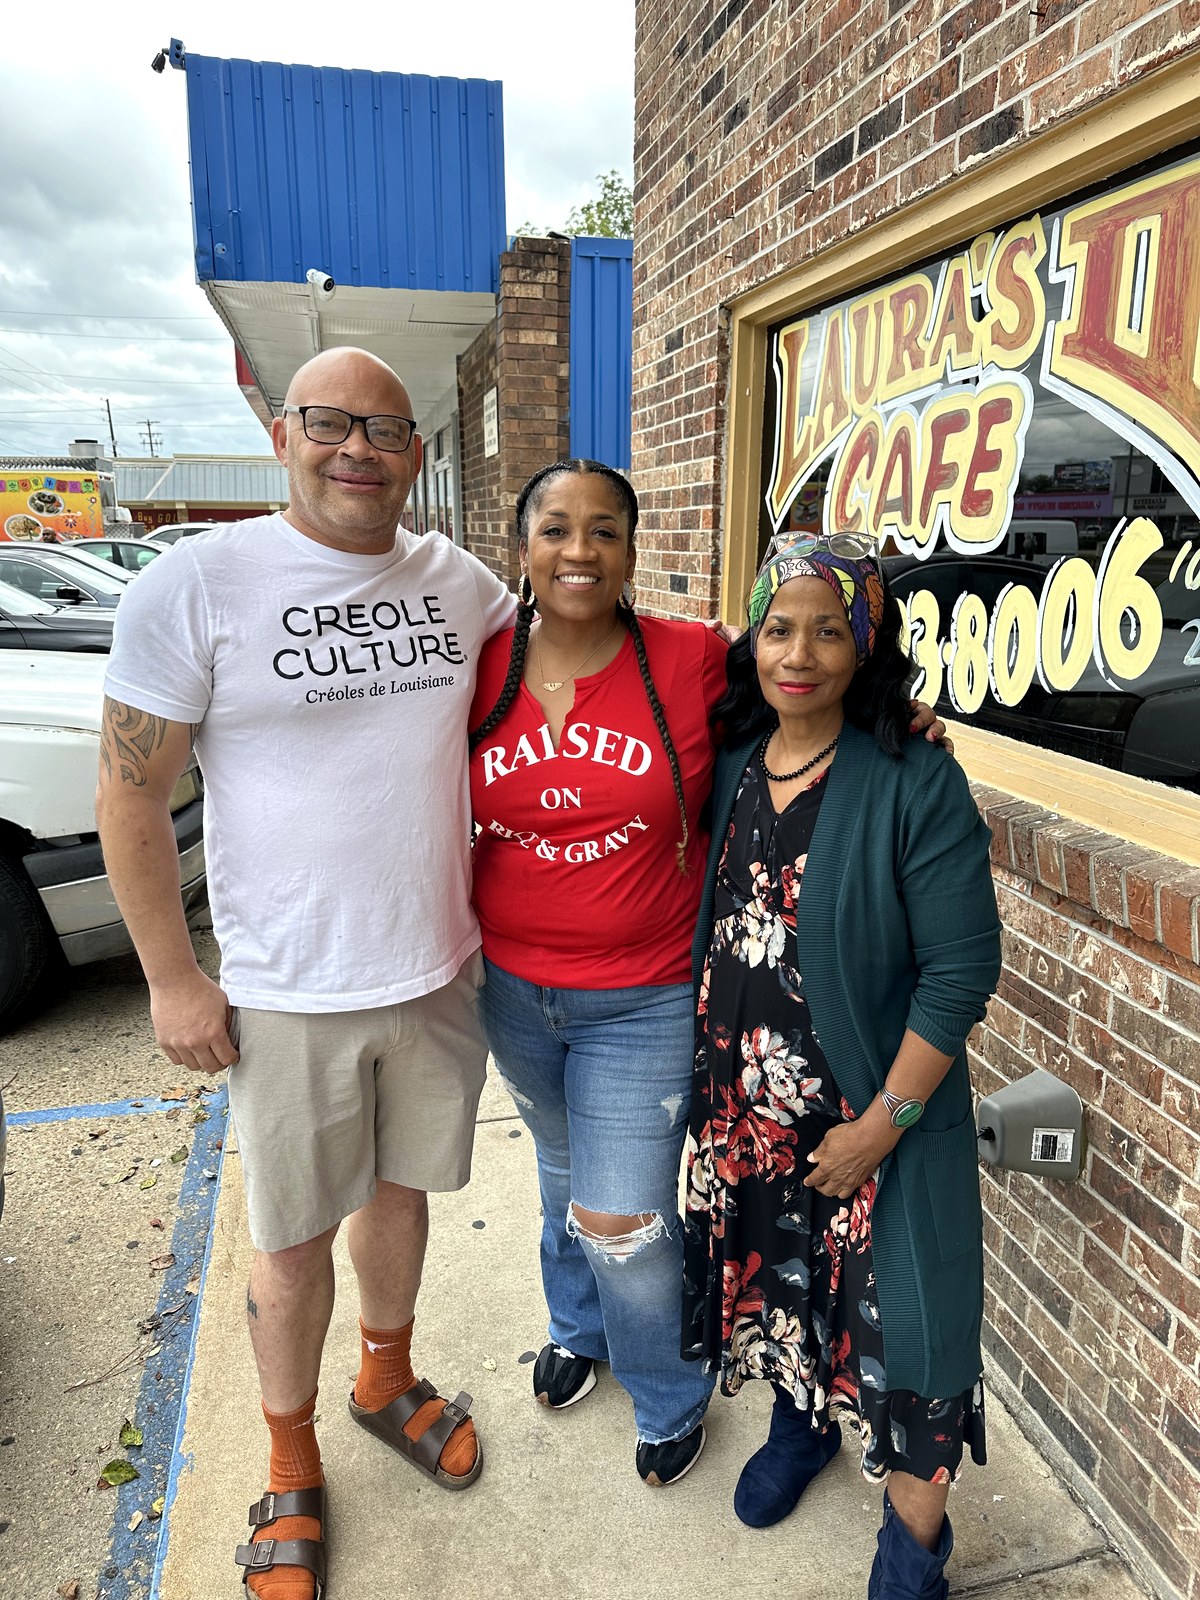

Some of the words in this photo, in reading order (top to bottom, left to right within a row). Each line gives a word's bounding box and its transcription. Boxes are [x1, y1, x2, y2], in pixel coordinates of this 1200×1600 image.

[771, 213, 1047, 522] LAURA'S
[830, 384, 1025, 547] CAFE
[137, 511, 153, 524] Buy
[282, 595, 446, 637] CREOLE
[272, 632, 465, 680] CULTURE
[305, 686, 365, 704] Créoles
[369, 681, 386, 697] de
[390, 674, 455, 695] Louisiane
[480, 722, 653, 787] RAISED
[540, 787, 582, 810] ON
[535, 838, 560, 861] &
[564, 814, 650, 863] GRAVY
